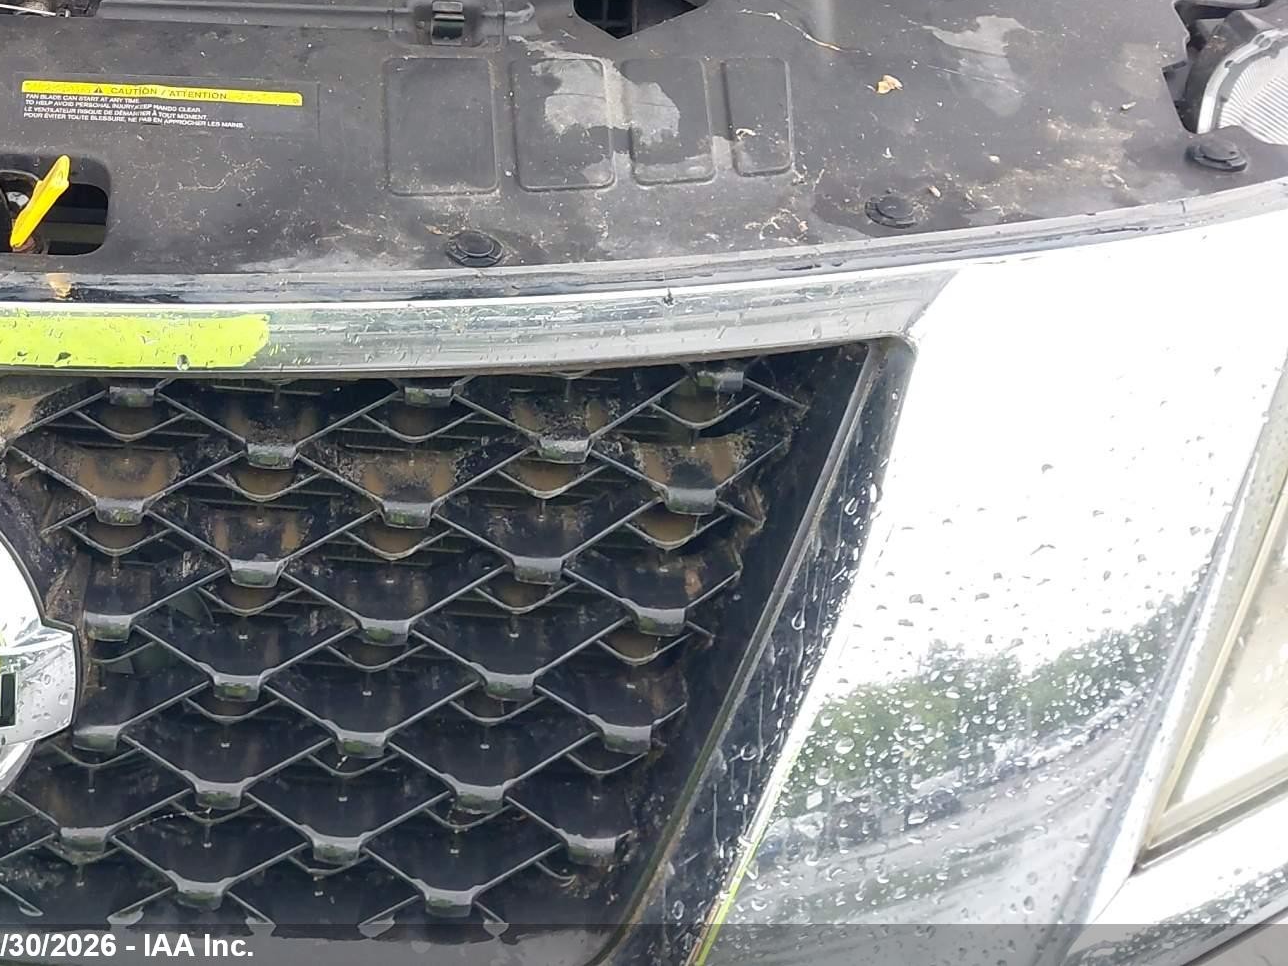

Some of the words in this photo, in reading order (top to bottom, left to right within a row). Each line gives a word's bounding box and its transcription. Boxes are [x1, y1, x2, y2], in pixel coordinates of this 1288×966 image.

[110, 87, 157, 95] CAUTION
[169, 91, 227, 99] ATTENTION
[158, 111, 176, 119] TOUT
